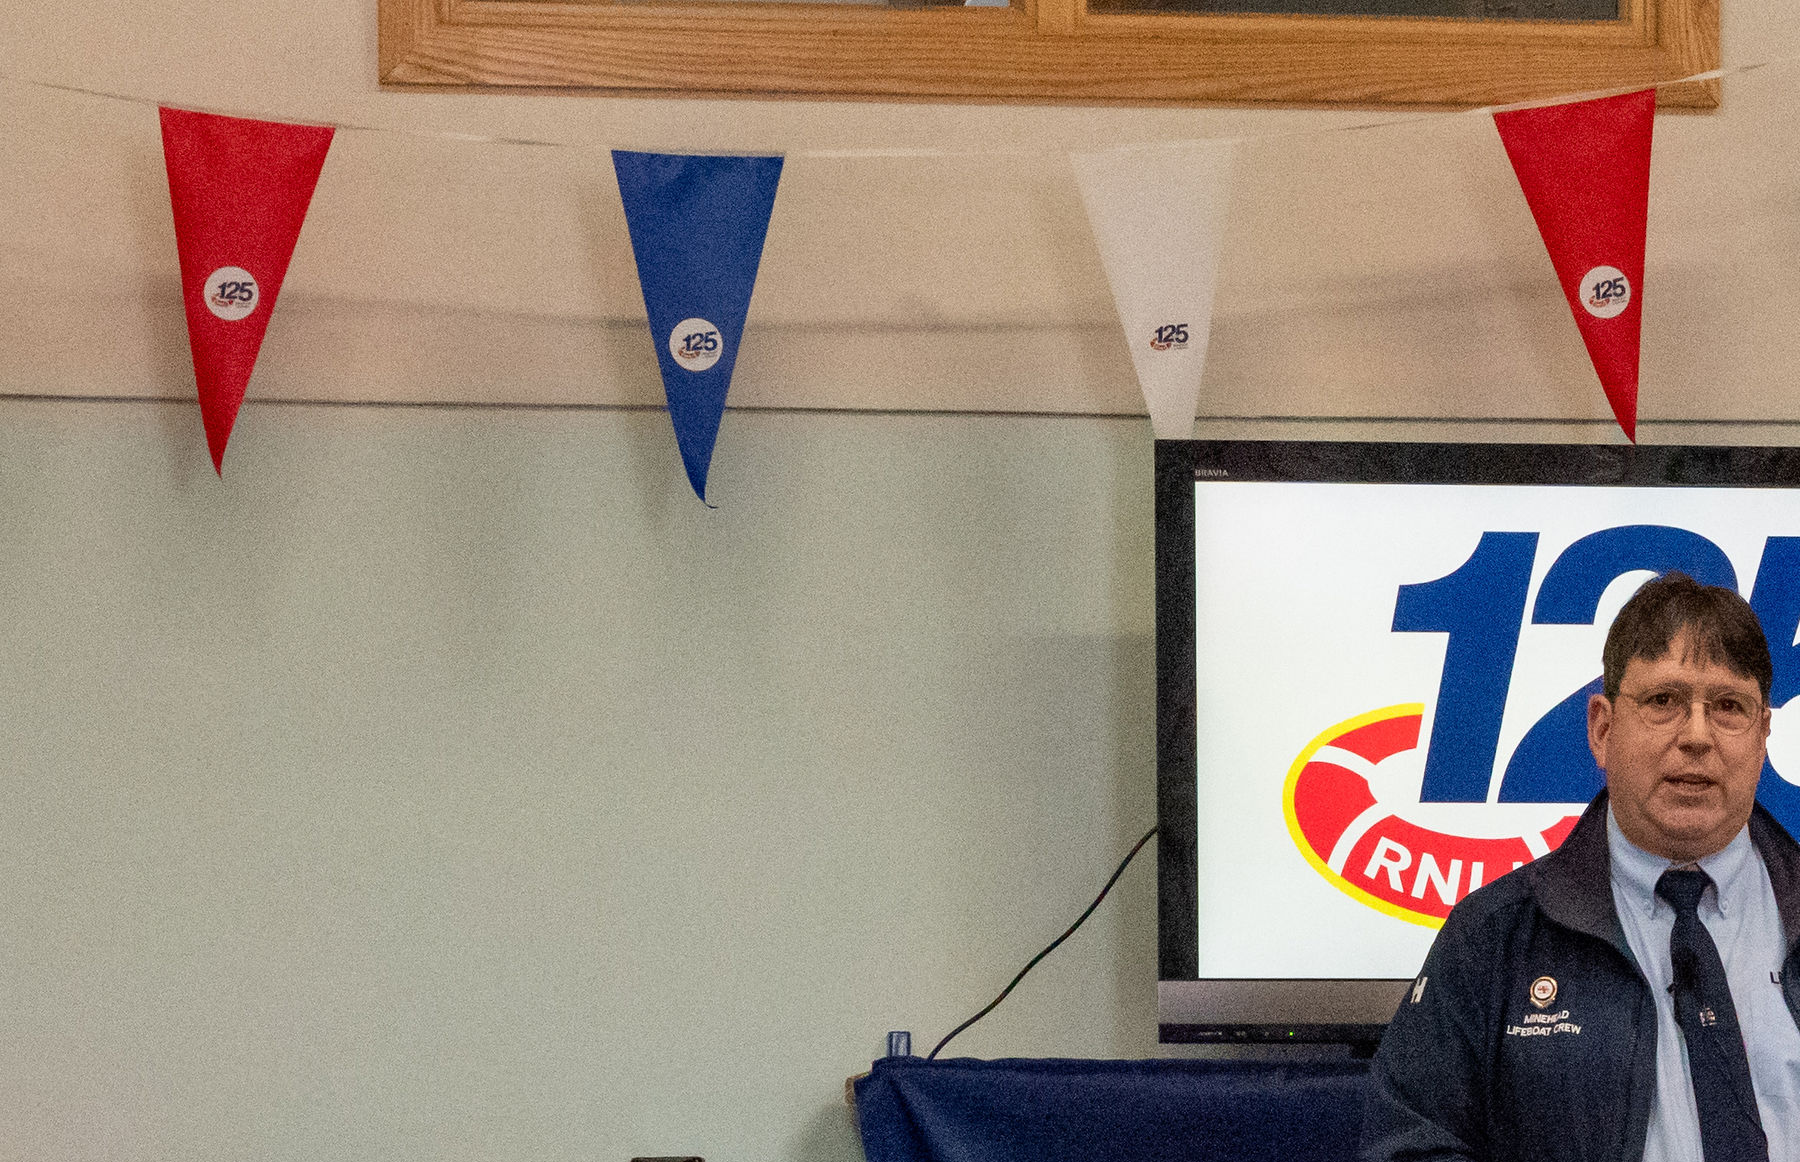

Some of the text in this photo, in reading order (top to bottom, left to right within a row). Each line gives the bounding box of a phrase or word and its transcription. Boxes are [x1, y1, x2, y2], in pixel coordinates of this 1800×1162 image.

[218, 281, 254, 302] 125
[1592, 277, 1626, 300] 125
[683, 331, 718, 351] 125
[1155, 323, 1189, 343] 125
[1506, 1023, 1582, 1037] LIFEBOAT CREW
